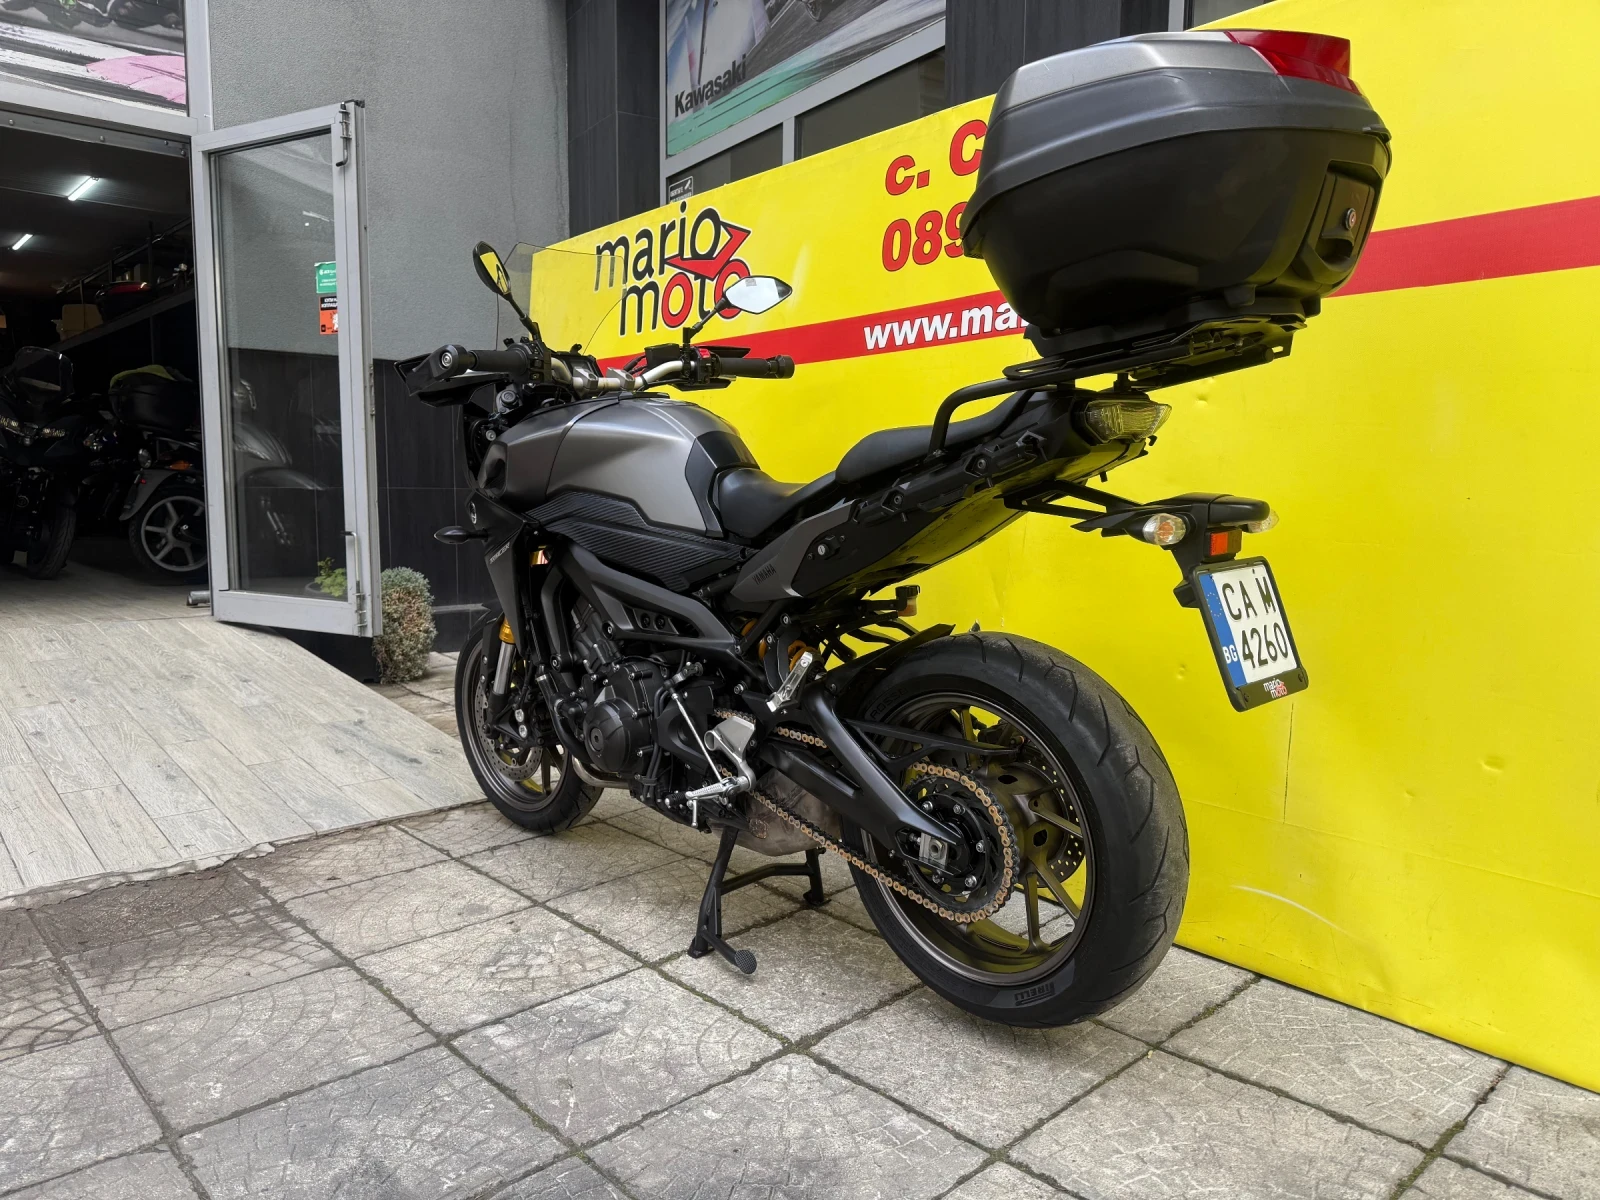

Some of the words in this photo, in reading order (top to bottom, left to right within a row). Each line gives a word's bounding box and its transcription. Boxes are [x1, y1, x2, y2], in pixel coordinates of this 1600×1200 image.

[674, 54, 747, 117] Kawasaki
[594, 200, 722, 291] mario
[619, 258, 751, 336] moto
[863, 301, 1029, 350] www.ma
[752, 563, 777, 585] YAMAHA
[1222, 580, 1258, 620] CA
[1254, 576, 1277, 614] M
[1222, 644, 1238, 664] BG
[1241, 622, 1289, 669] 4260
[870, 687, 909, 720] ROSSO
[1014, 981, 1055, 1006] PIRELLI
